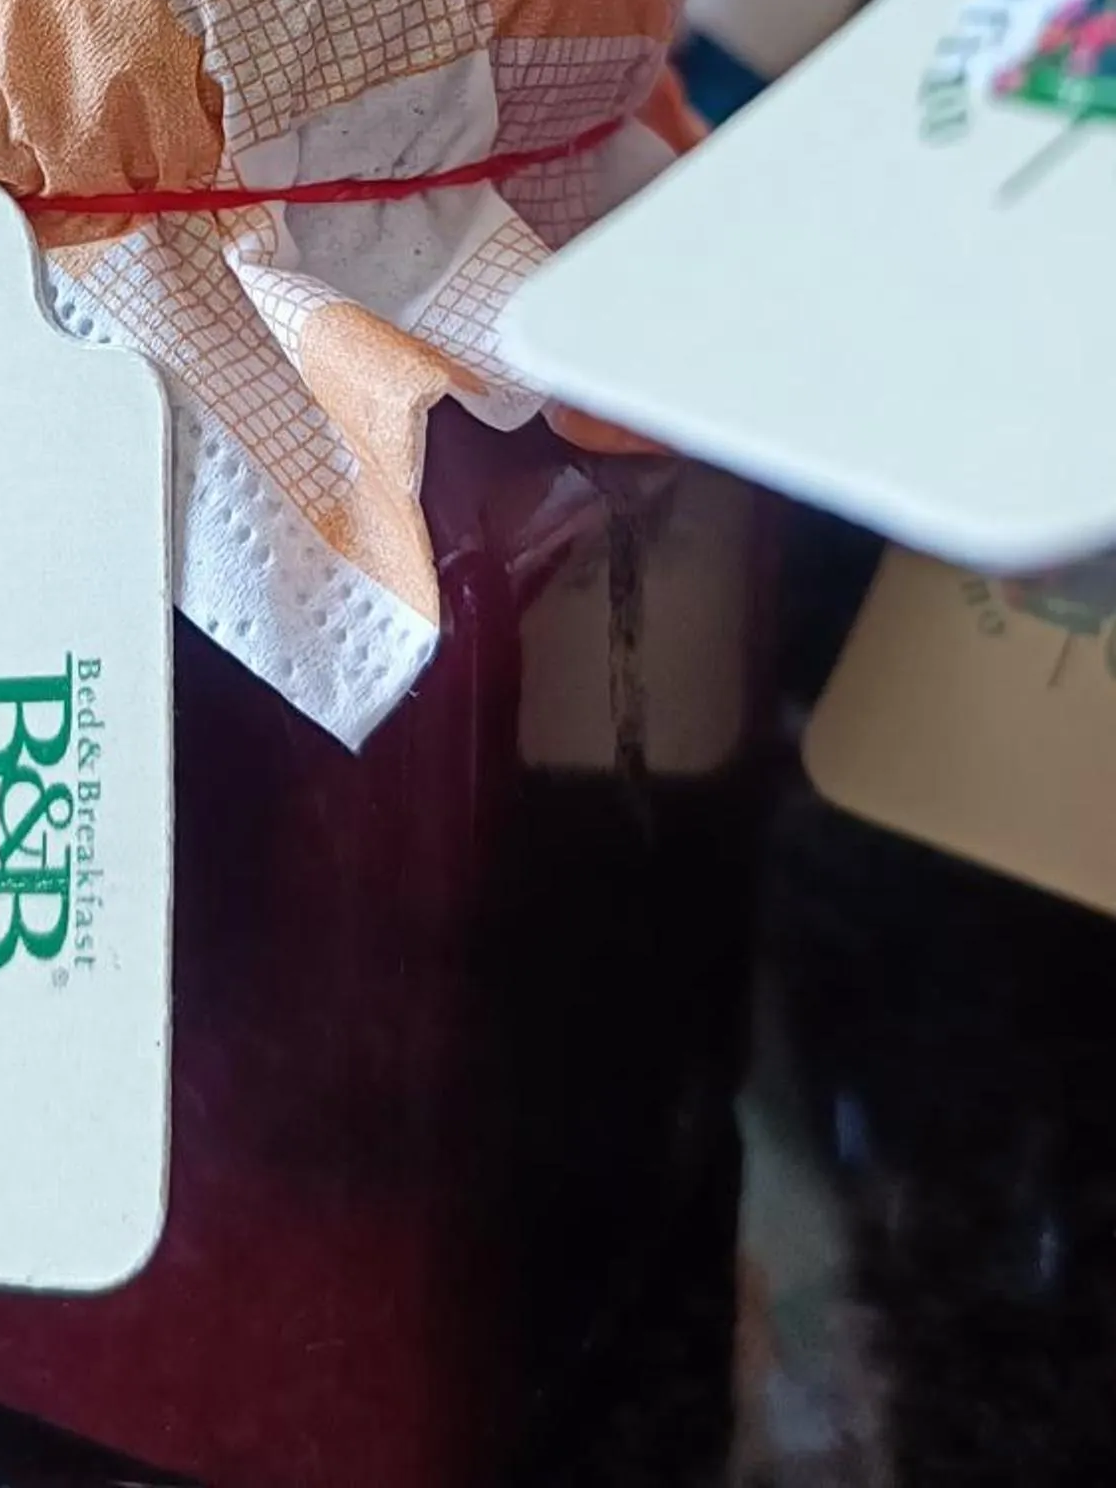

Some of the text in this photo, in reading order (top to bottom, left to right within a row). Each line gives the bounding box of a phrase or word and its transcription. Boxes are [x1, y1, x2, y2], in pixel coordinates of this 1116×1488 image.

[74, 657, 105, 971] Bed & Breakfast
